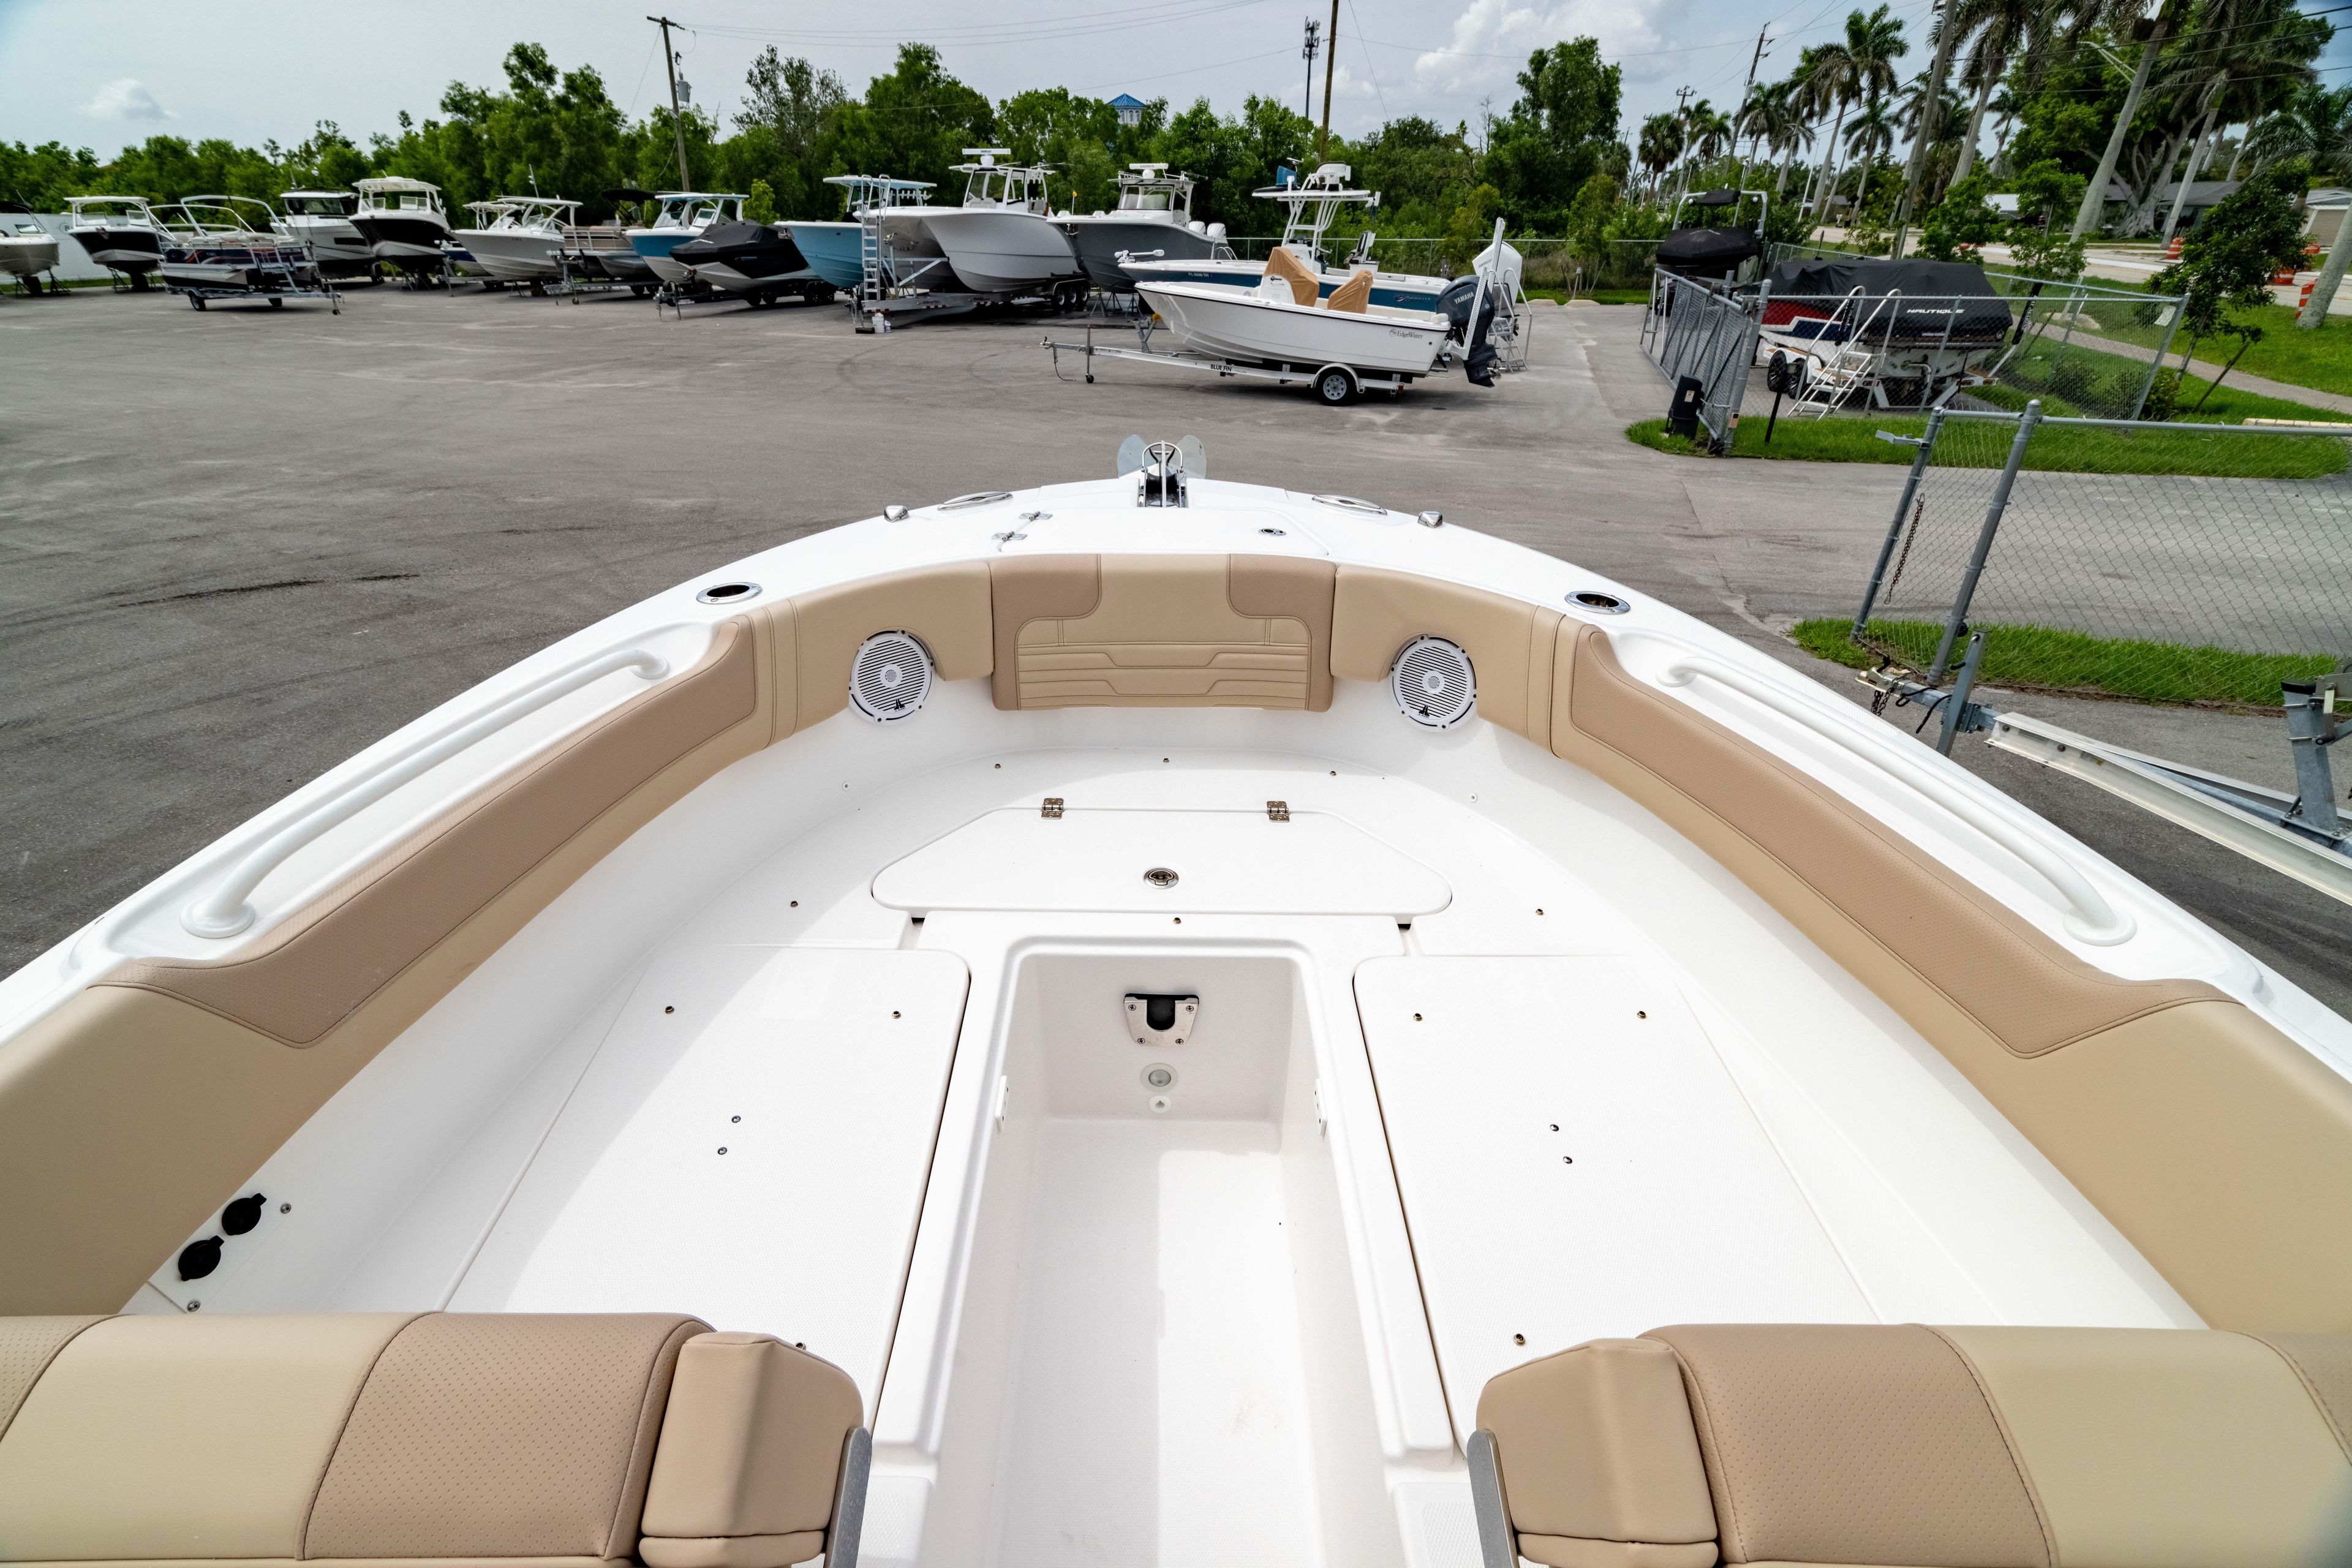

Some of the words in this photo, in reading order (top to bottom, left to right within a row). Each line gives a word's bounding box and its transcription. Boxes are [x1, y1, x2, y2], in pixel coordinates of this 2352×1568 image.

[1478, 258, 1493, 268] MERCU
[1454, 292, 1474, 304] YAMAHA
[1396, 330, 1423, 339] EdgeWater
